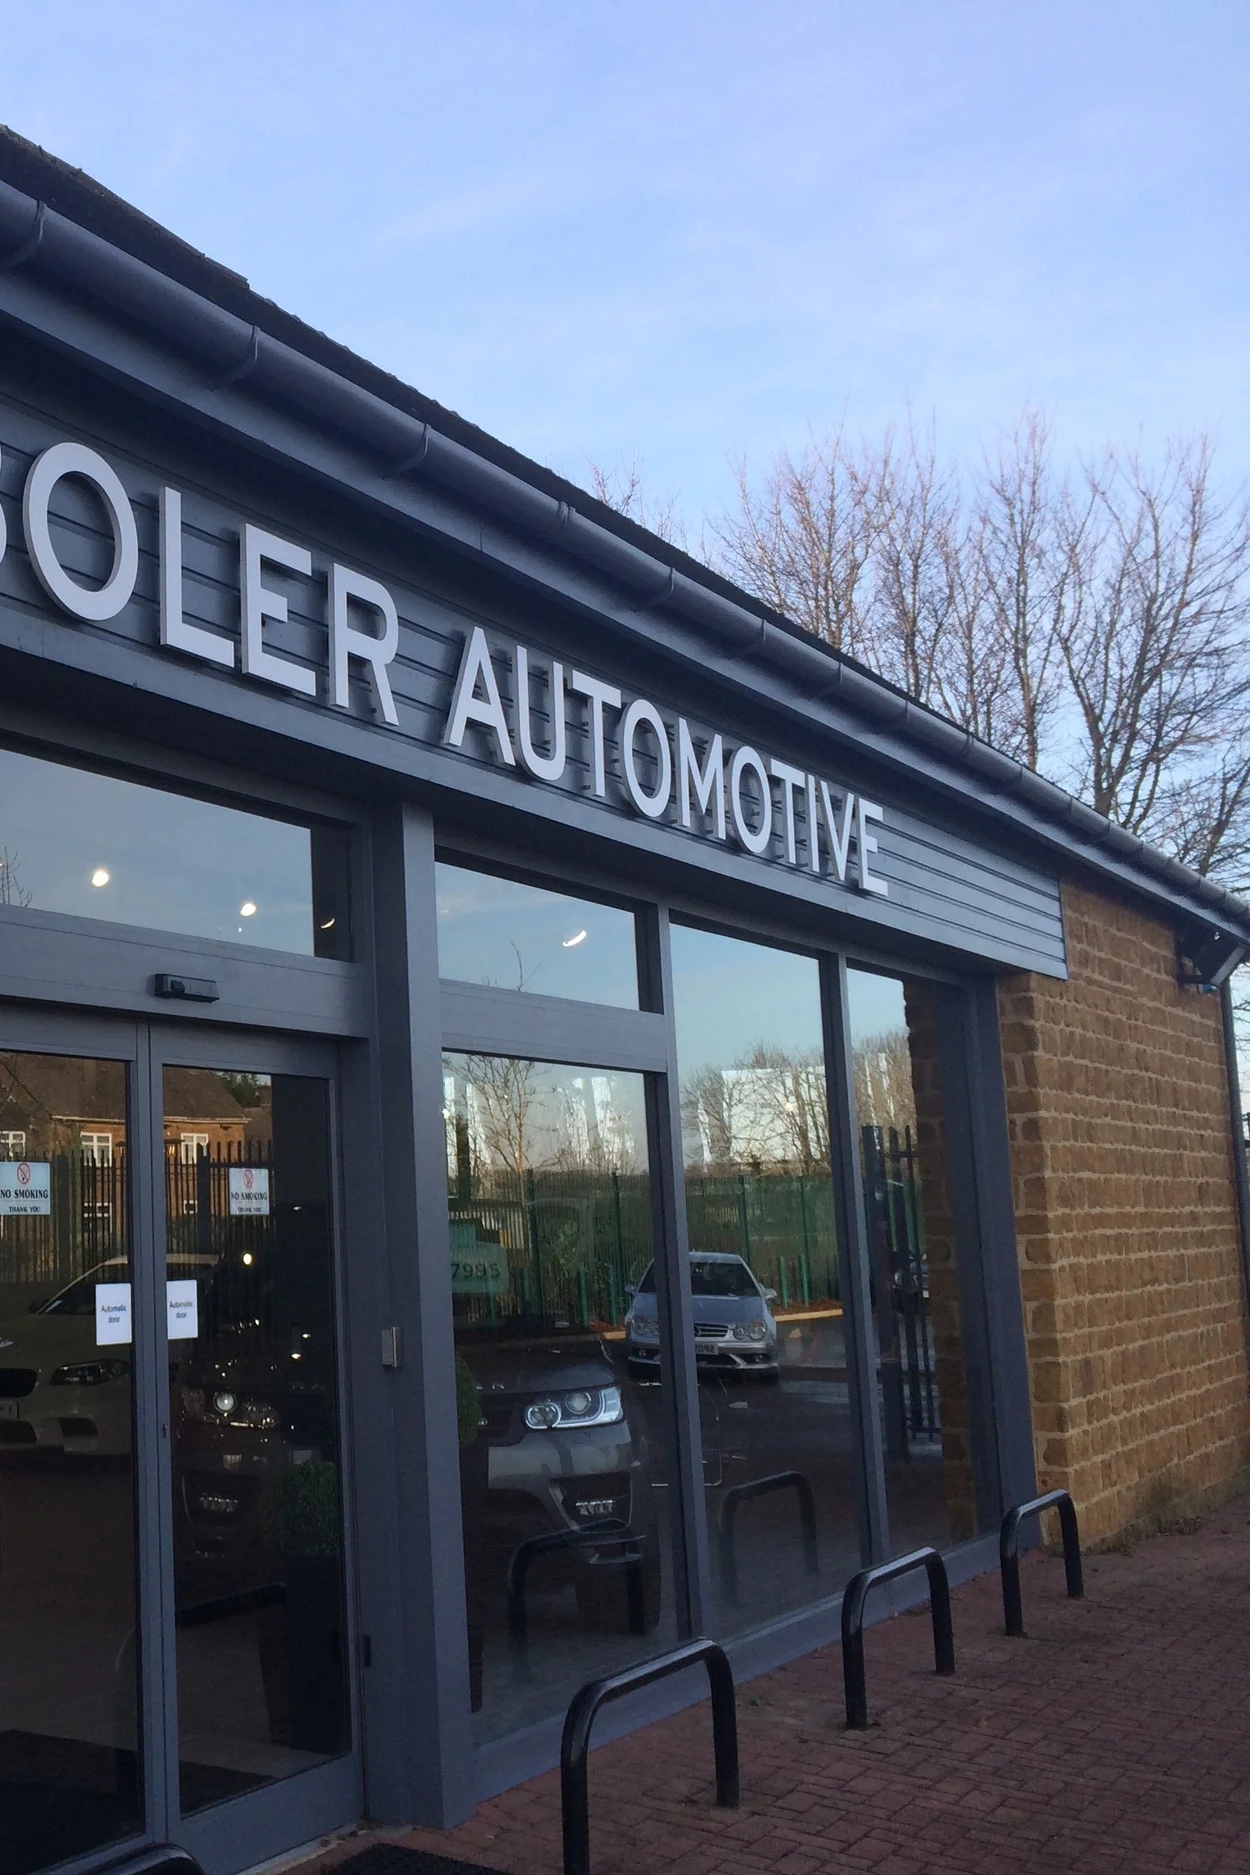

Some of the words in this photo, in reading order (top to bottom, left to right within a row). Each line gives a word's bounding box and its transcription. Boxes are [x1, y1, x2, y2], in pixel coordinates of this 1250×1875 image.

[443, 626, 890, 897] AUTOMOTIVE
[0, 1189, 11, 1199] NO
[13, 1189, 49, 1199] SMOKING
[230, 1192, 240, 1201] NO
[240, 1191, 268, 1201] SMOKING
[8, 1205, 28, 1213] THANK
[100, 1303, 127, 1313] Automatic
[168, 1300, 194, 1309] Automatic
[107, 1316, 121, 1324] door
[175, 1311, 188, 1320] door
